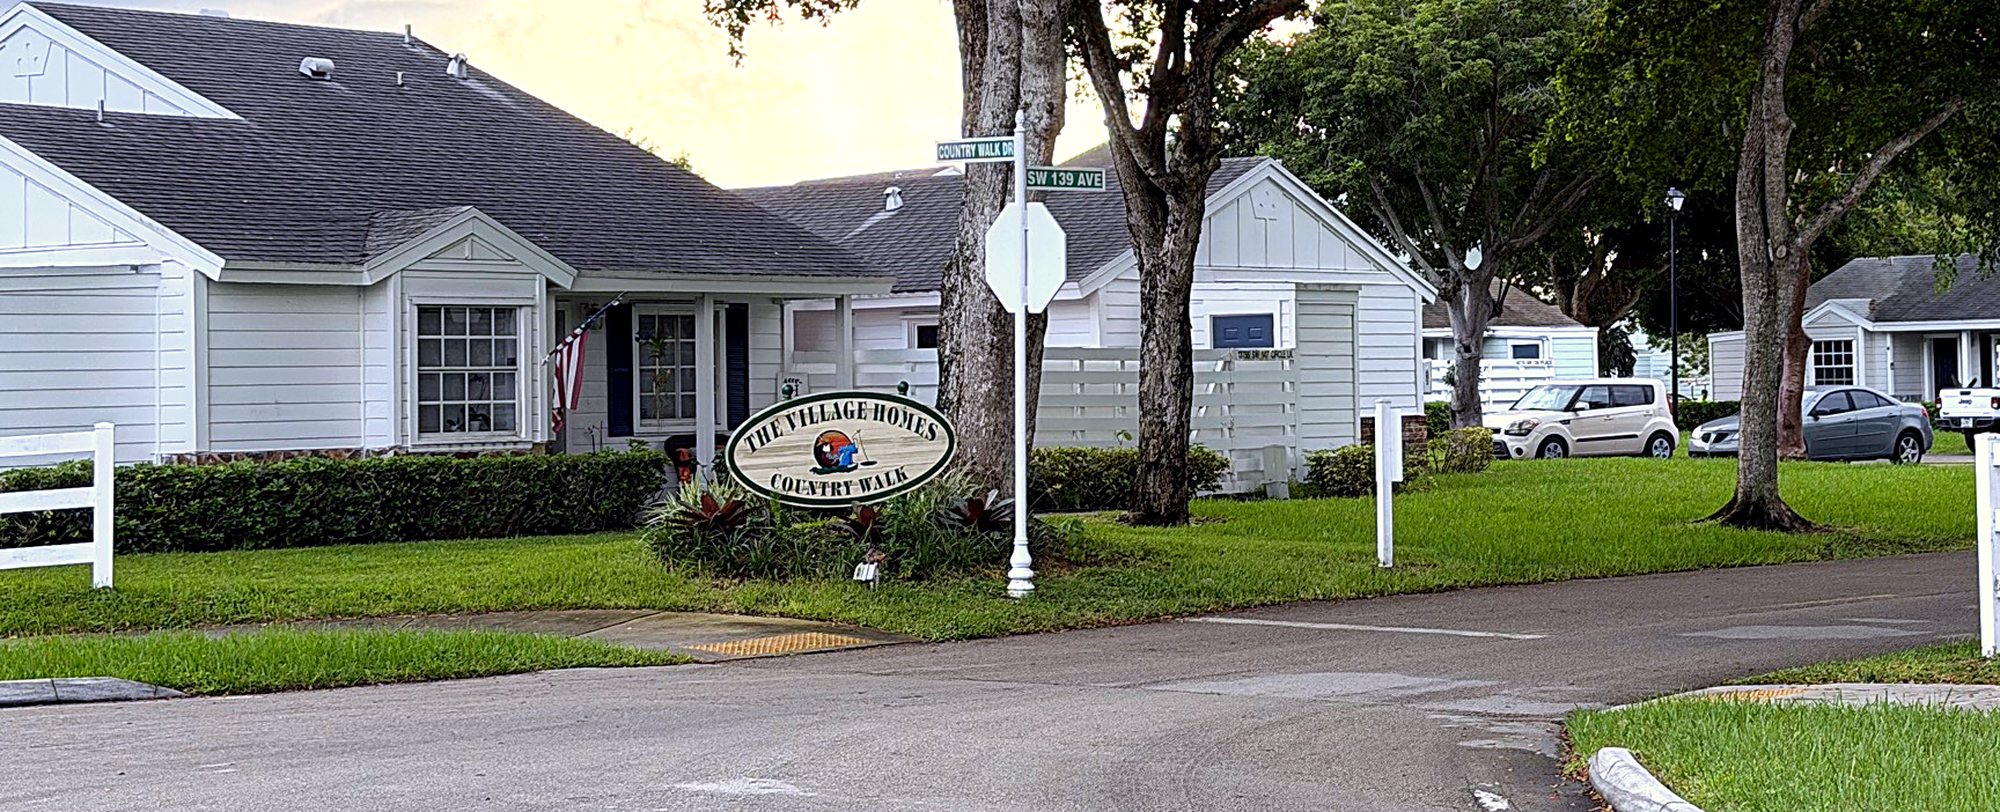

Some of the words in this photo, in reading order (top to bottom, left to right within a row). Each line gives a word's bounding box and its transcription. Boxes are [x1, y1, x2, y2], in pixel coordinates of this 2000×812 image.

[939, 143, 976, 159] COUNTRY
[978, 141, 1000, 157] WALK
[1002, 141, 1014, 157] DR
[1027, 171, 1047, 186] SW
[1051, 171, 1074, 186] 139
[1077, 172, 1102, 187] AVE
[743, 420, 784, 453] THE
[785, 401, 868, 431] VILLAGE
[873, 403, 939, 441] HOMES
[770, 472, 853, 497] COUNTRY
[858, 466, 909, 492] WALK
